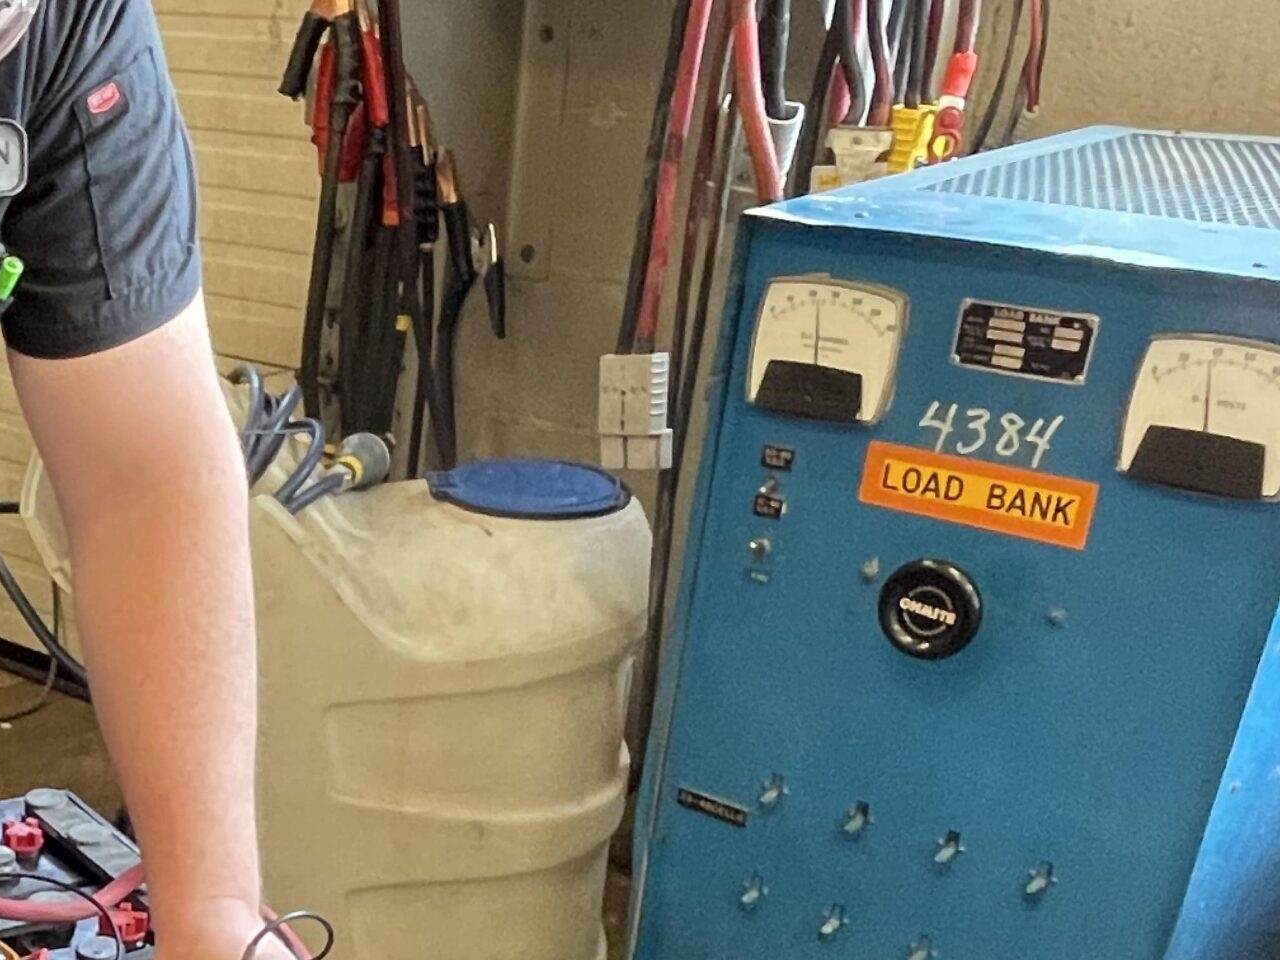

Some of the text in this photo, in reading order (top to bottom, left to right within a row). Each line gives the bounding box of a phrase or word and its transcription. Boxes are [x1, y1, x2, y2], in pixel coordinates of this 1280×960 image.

[918, 400, 1064, 469] 4384
[882, 463, 1075, 526] LOAD BANK
